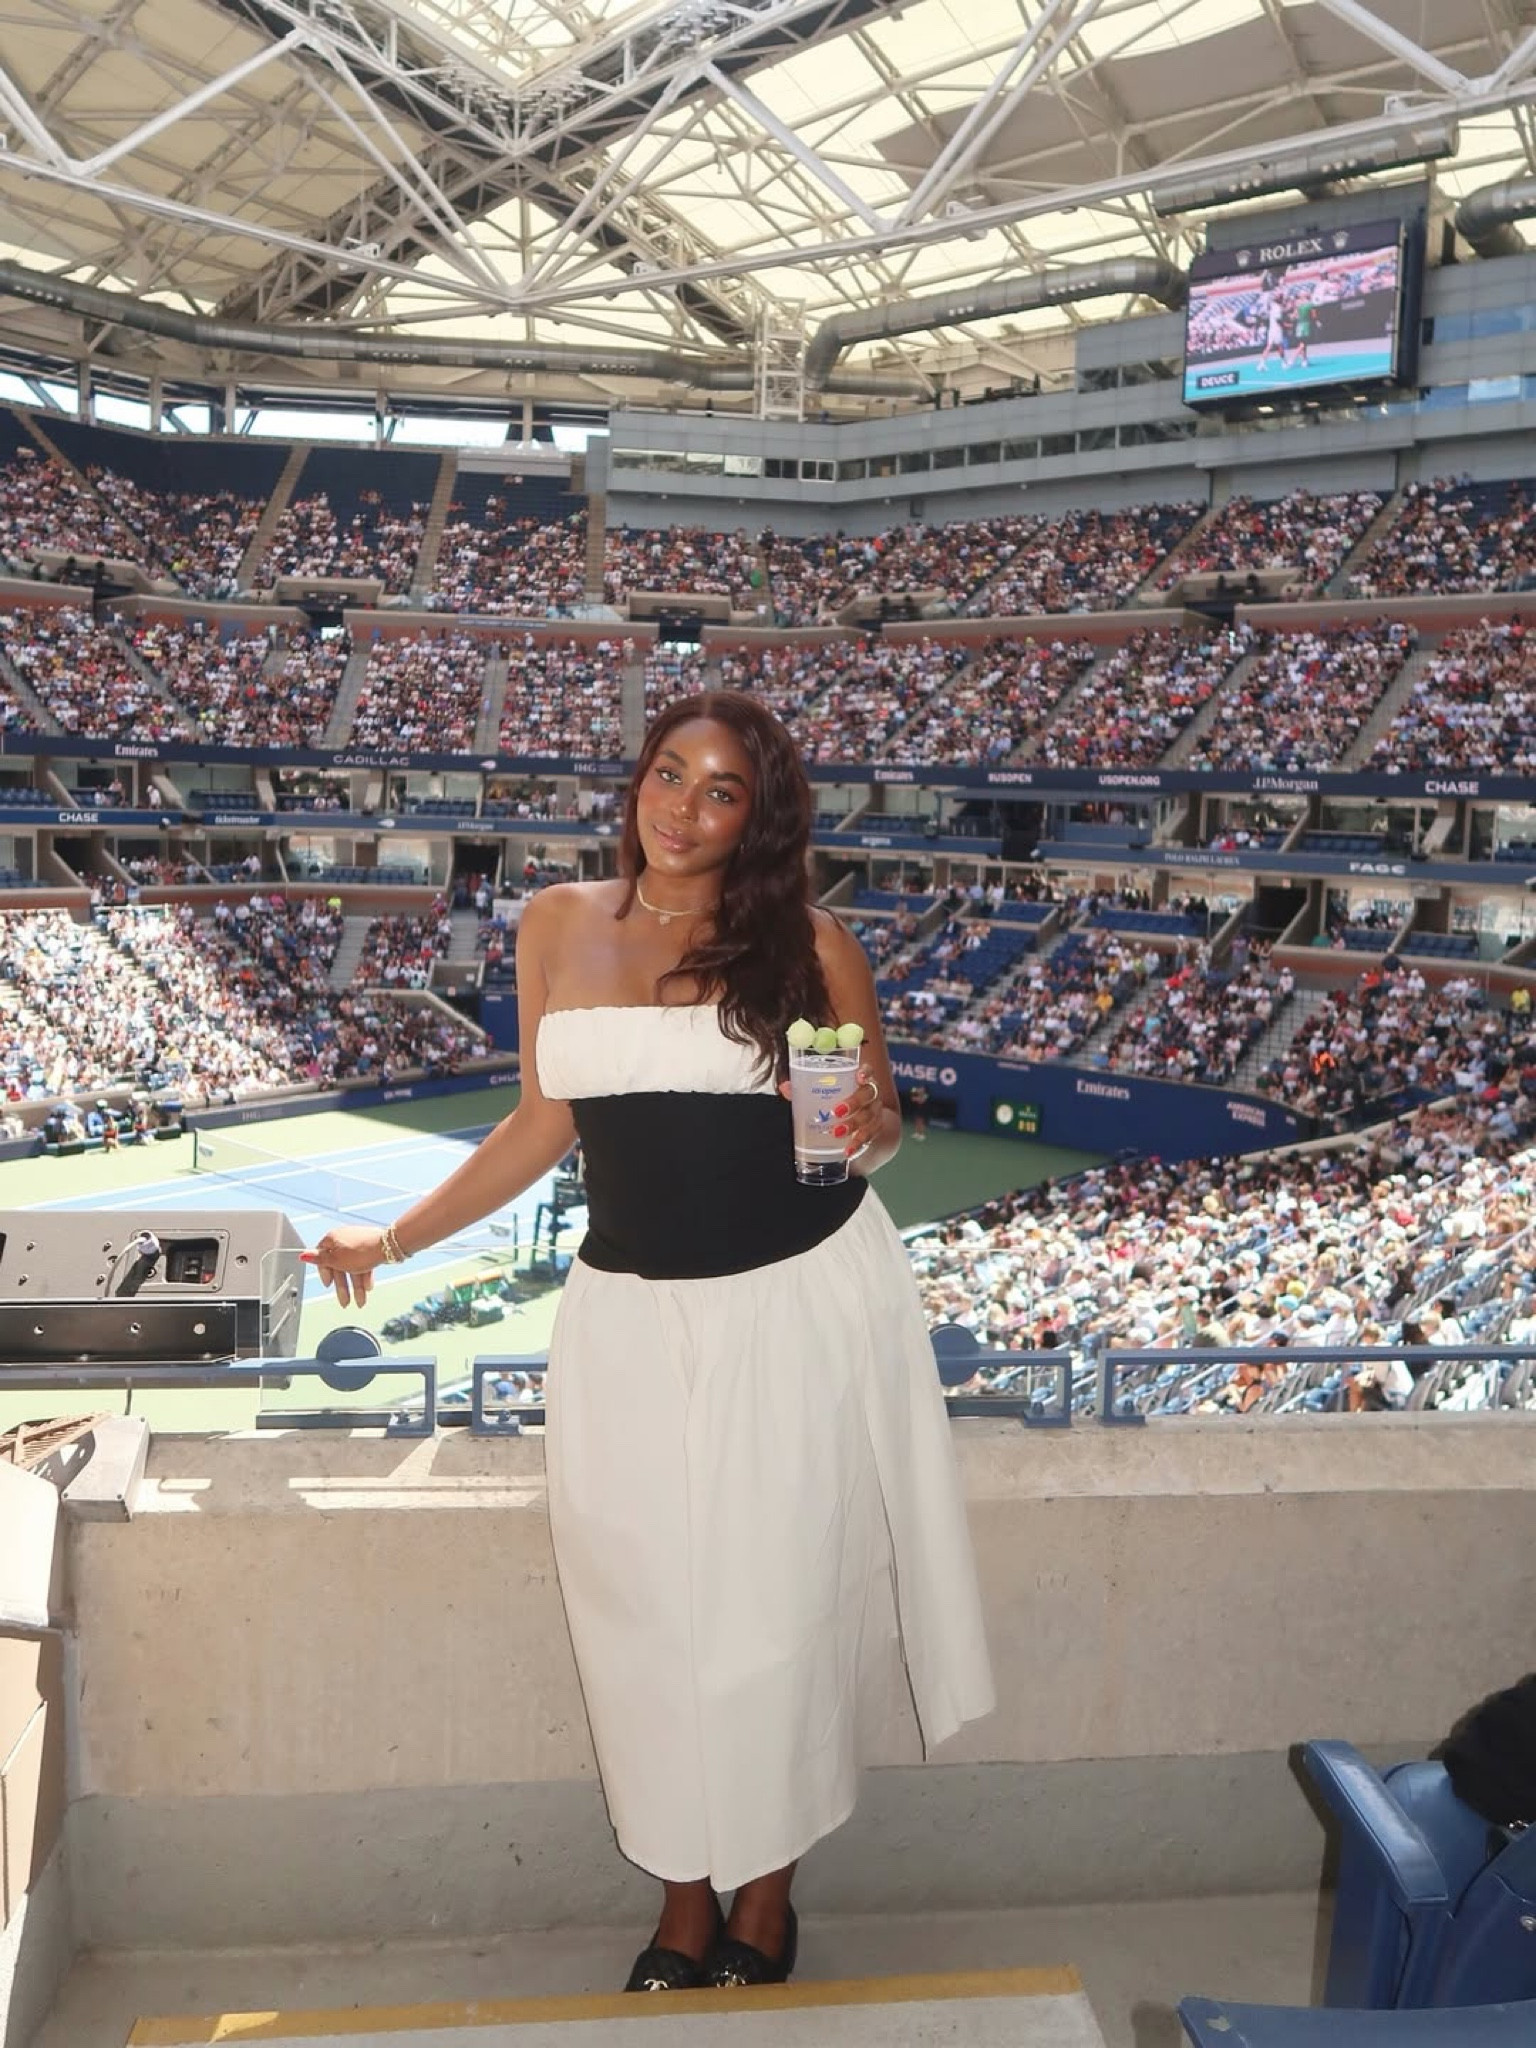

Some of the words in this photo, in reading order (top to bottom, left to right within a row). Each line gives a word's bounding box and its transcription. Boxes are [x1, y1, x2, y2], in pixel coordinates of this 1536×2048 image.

[1259, 237, 1324, 263] ROLEX
[1200, 373, 1236, 388] DEUCE
[114, 744, 159, 758] Emirates
[333, 754, 411, 767] CADILLAC
[1424, 780, 1480, 795] CHASE
[58, 812, 99, 823] CHASE
[891, 1061, 938, 1082] HASE
[1076, 1078, 1131, 1100] Emirates
